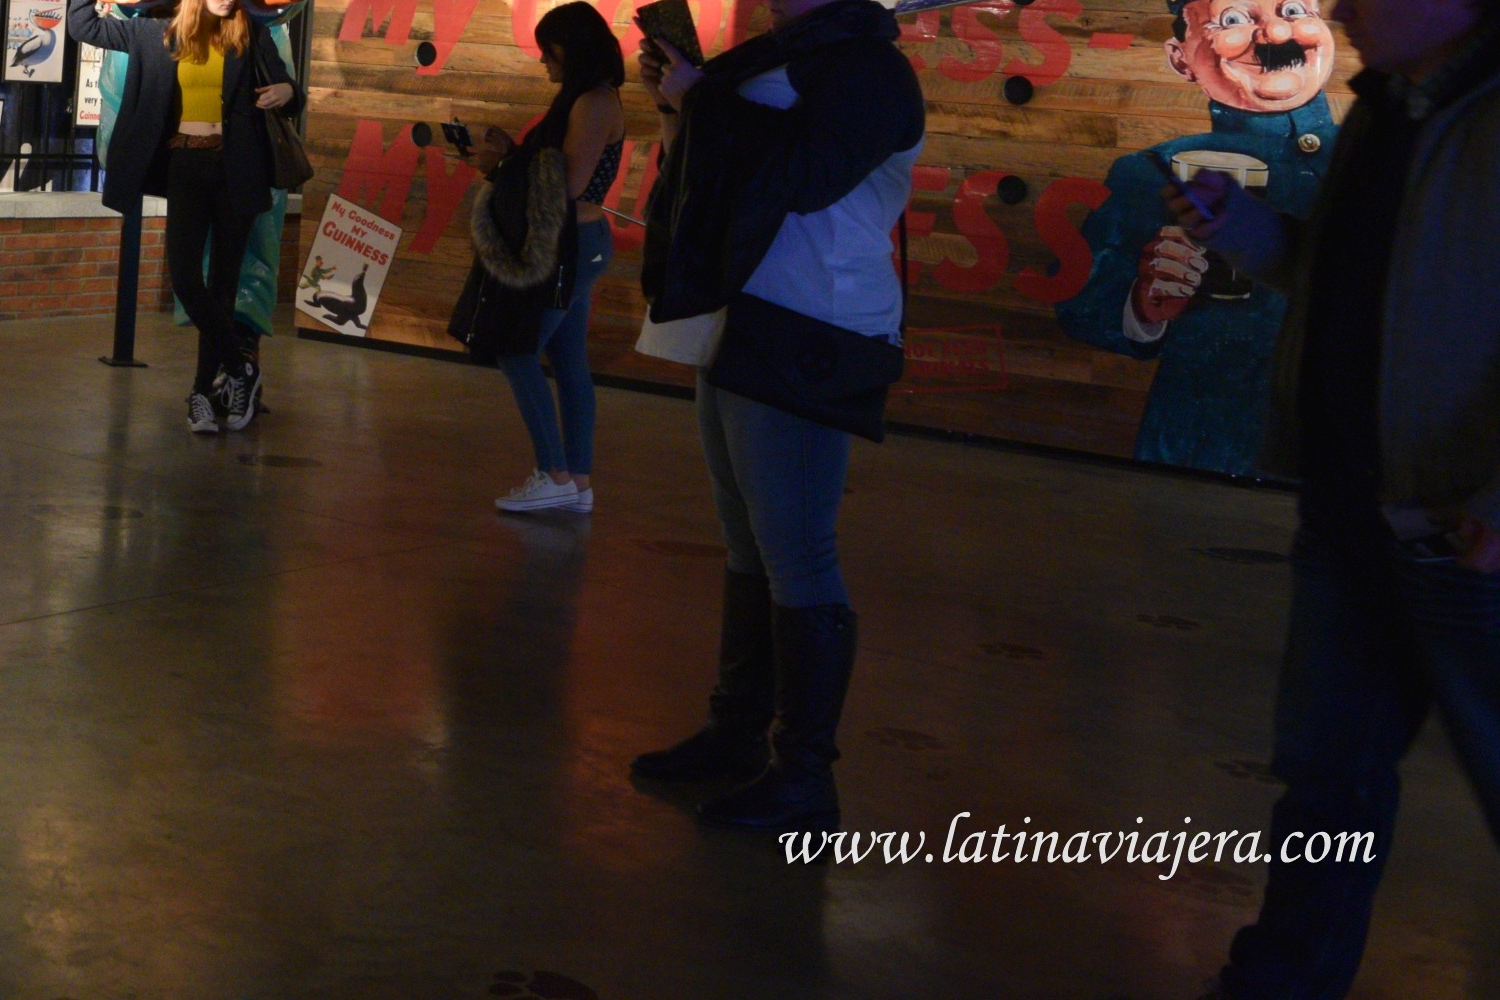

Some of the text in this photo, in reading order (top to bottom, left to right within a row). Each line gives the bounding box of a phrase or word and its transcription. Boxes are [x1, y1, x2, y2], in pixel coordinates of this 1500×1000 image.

[84, 97, 98, 107] very
[85, 78, 93, 88] As
[338, 119, 479, 255] My
[331, 201, 396, 241] My Goodness
[322, 220, 389, 266] GUINNESS
